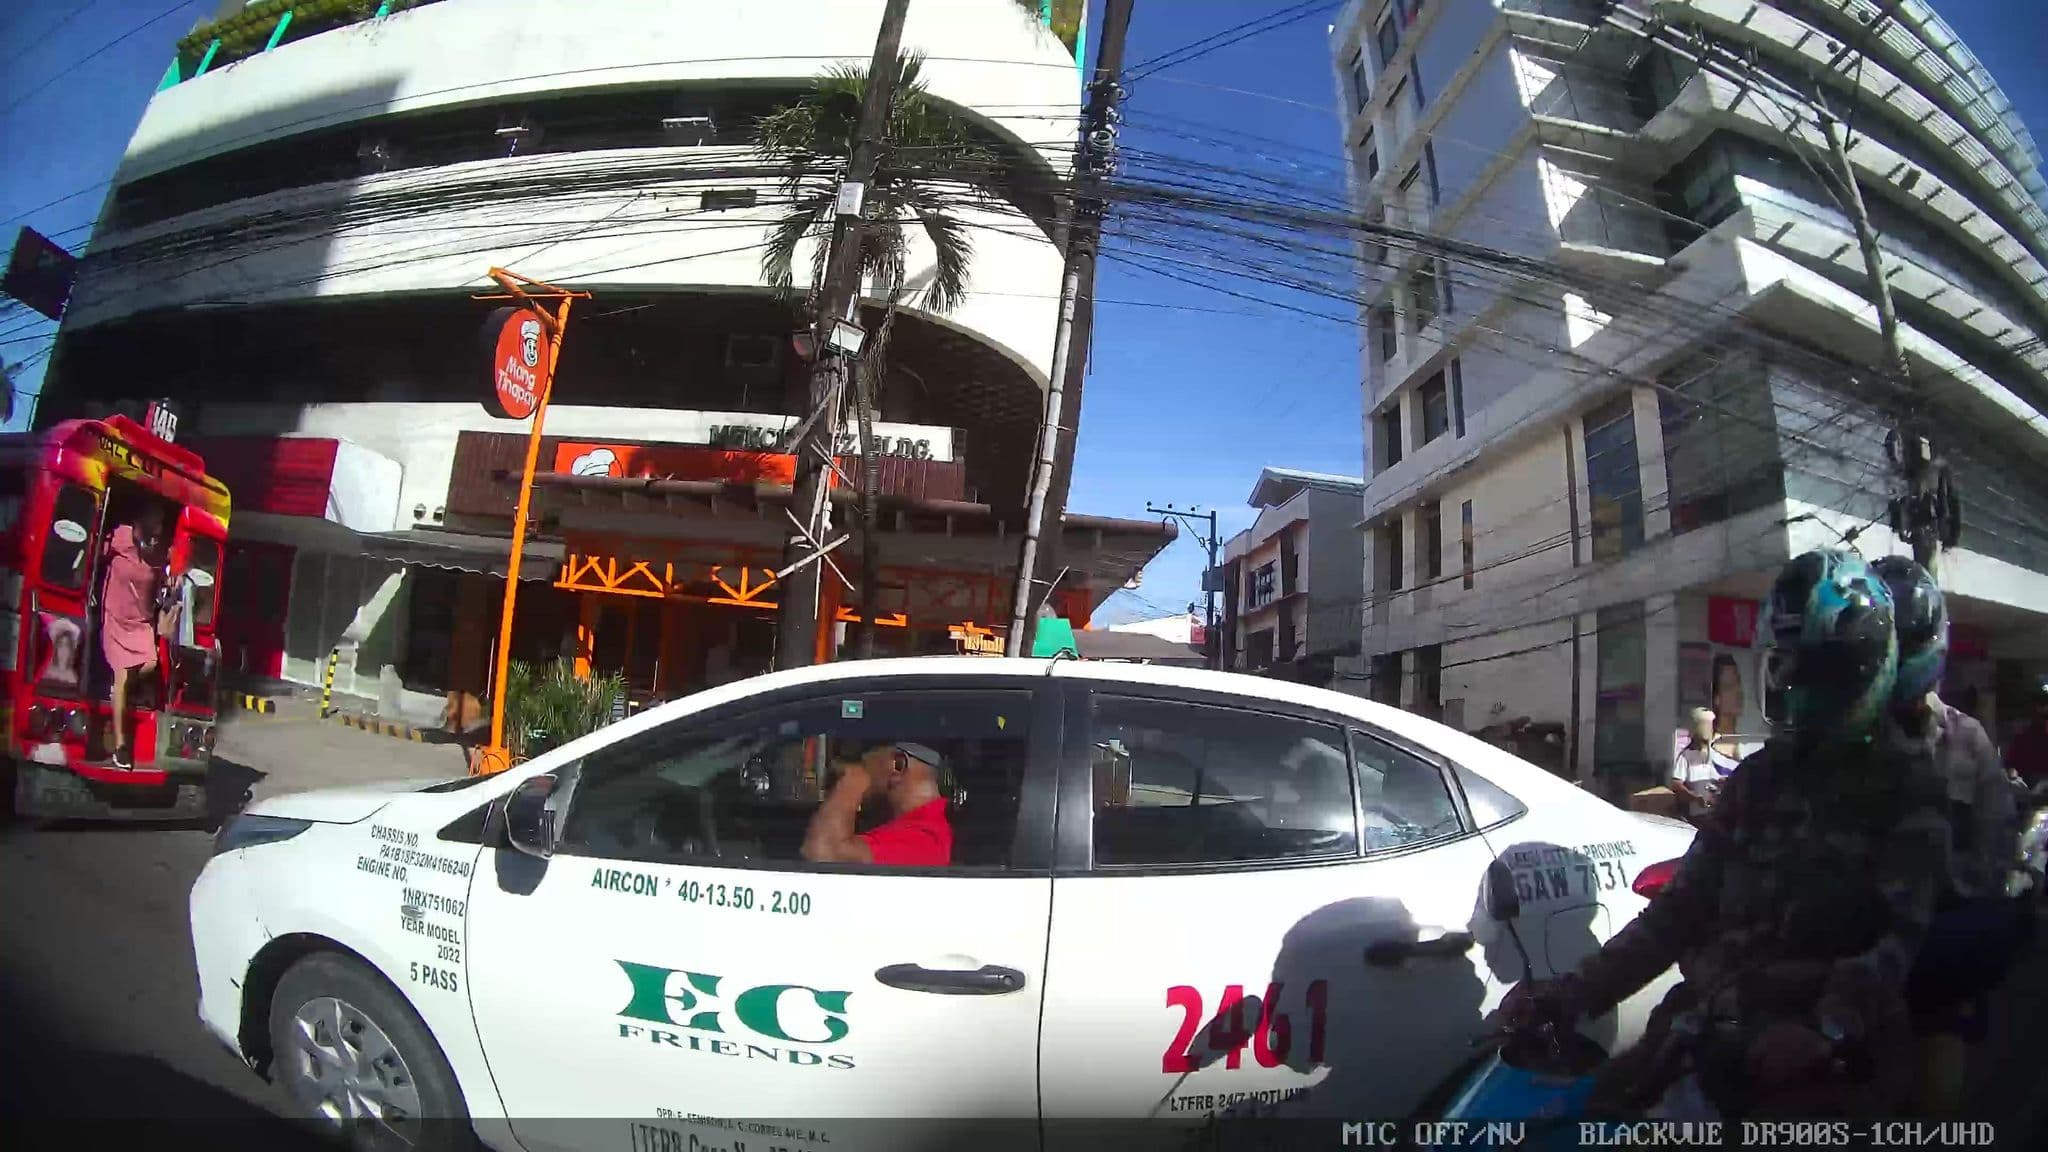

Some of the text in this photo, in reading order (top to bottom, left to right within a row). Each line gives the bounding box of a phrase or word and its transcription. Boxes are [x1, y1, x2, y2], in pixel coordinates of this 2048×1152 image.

[505, 355, 536, 391] Mang
[498, 369, 537, 411] Tinapay
[371, 824, 404, 844] CHASSIS
[357, 856, 391, 878] ENGINE
[1575, 860, 1628, 895] 7131
[402, 887, 465, 917] 1NRX751062
[591, 868, 658, 897] AIRCON
[678, 880, 753, 909] 40-13.50
[771, 890, 811, 915] 2.00
[401, 916, 460, 945] YEAR MODEL
[437, 945, 460, 963] 2022
[410, 962, 458, 992] 5 PASS
[613, 959, 854, 1043] EC
[1162, 980, 1328, 1074] 2461
[618, 1024, 856, 1070] FRIENDS
[1170, 1094, 1214, 1112] LTFRB
